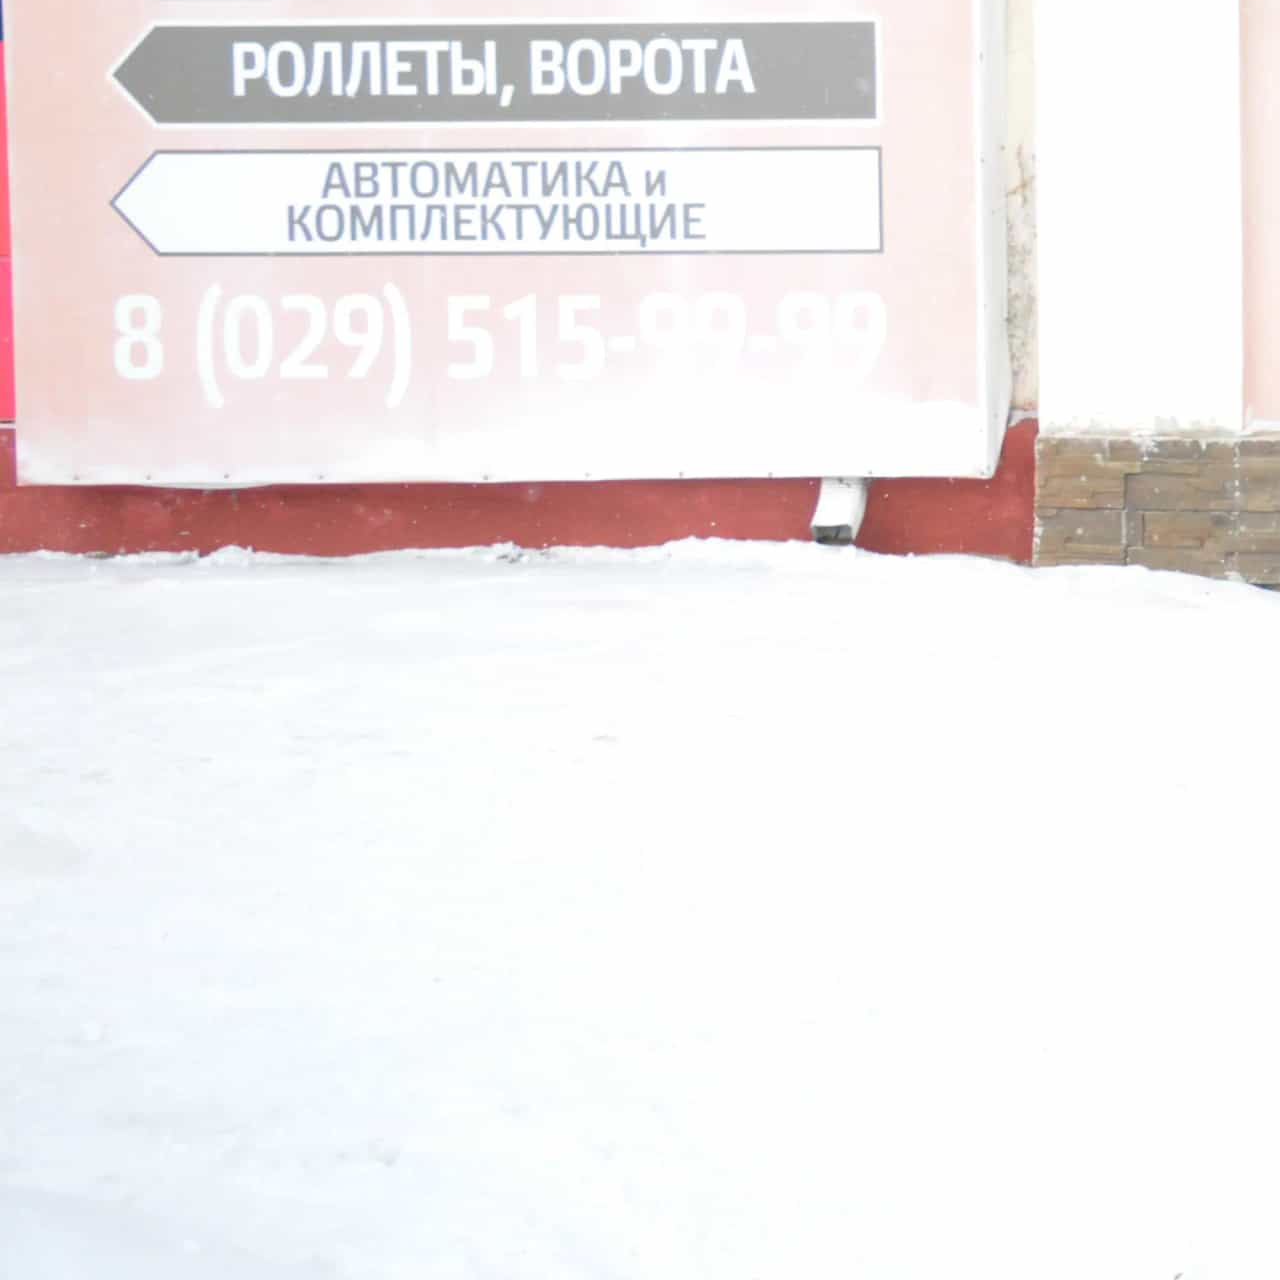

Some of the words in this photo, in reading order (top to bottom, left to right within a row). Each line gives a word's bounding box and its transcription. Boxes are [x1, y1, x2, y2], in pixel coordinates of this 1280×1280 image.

[231, 38, 514, 107] РОЛЛЕТЫ,
[529, 37, 756, 95] ВОРОТА
[321, 160, 631, 200] АВТОМАТИКА
[644, 170, 667, 198] и
[286, 203, 707, 249] КОМПЛЕКТУЮЩИЕ
[112, 291, 164, 382] 8
[196, 281, 413, 409] (029)
